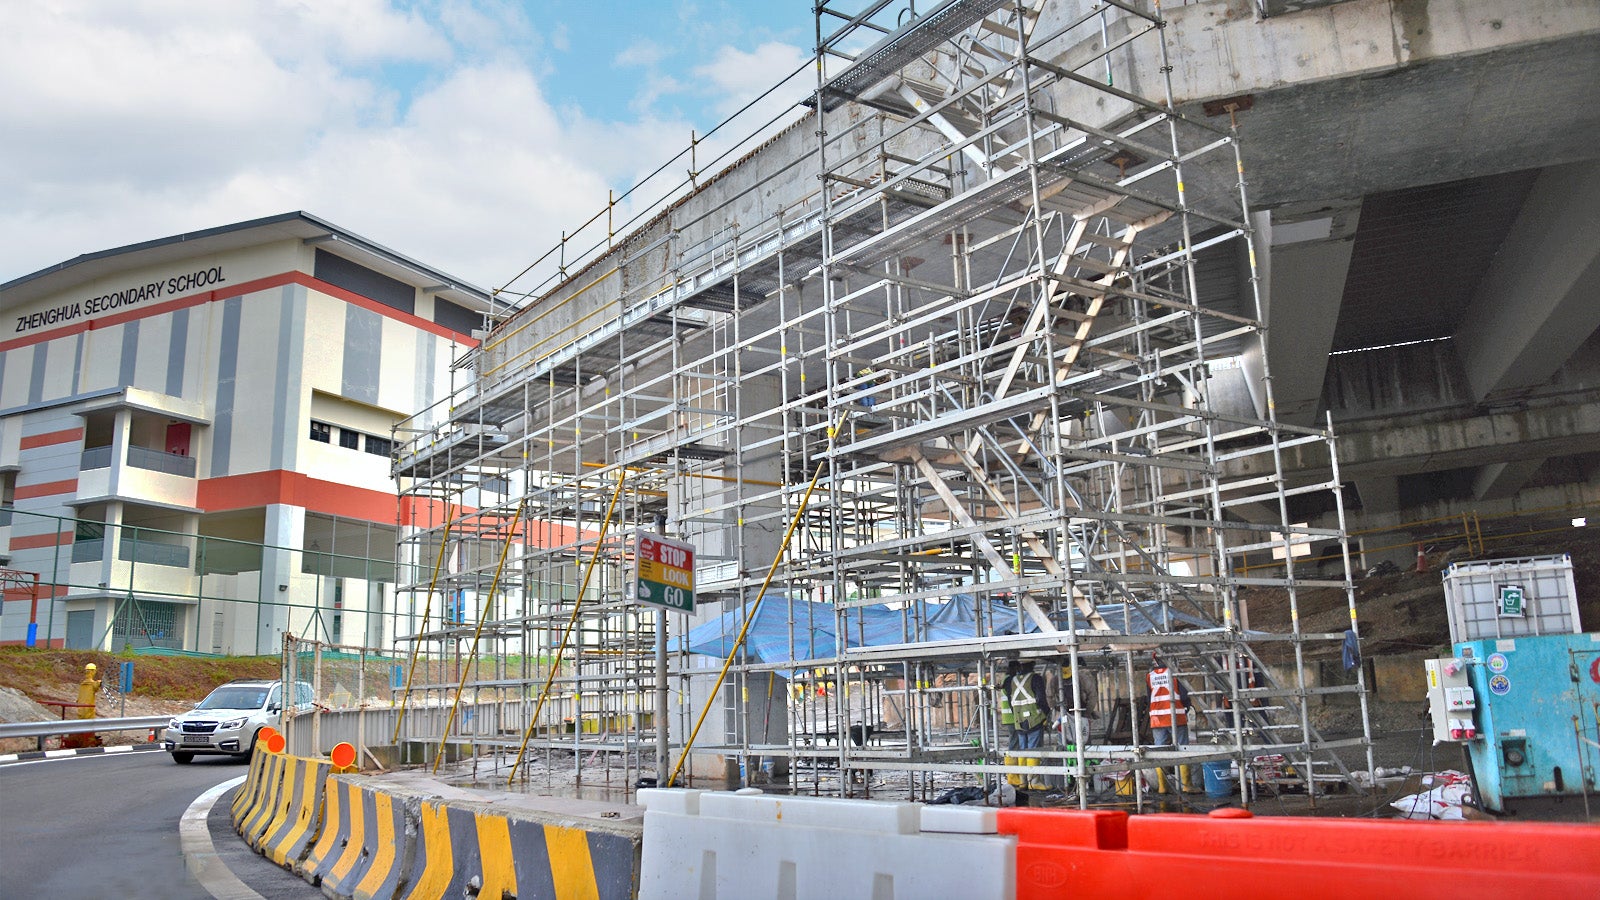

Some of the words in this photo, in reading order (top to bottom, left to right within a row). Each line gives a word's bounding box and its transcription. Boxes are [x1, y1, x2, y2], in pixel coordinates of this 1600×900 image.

[15, 302, 81, 332] ZHENGHUA
[83, 281, 166, 315] SECONDARY
[167, 266, 225, 294] SCHOOL
[660, 545, 686, 568] STOP
[663, 567, 689, 586] LOOK
[664, 586, 684, 607] GO
[1198, 830, 1239, 849] THIS
[1246, 832, 1262, 850] IS
[1267, 834, 1307, 852] NOT
[1335, 838, 1425, 858] SAFETY
